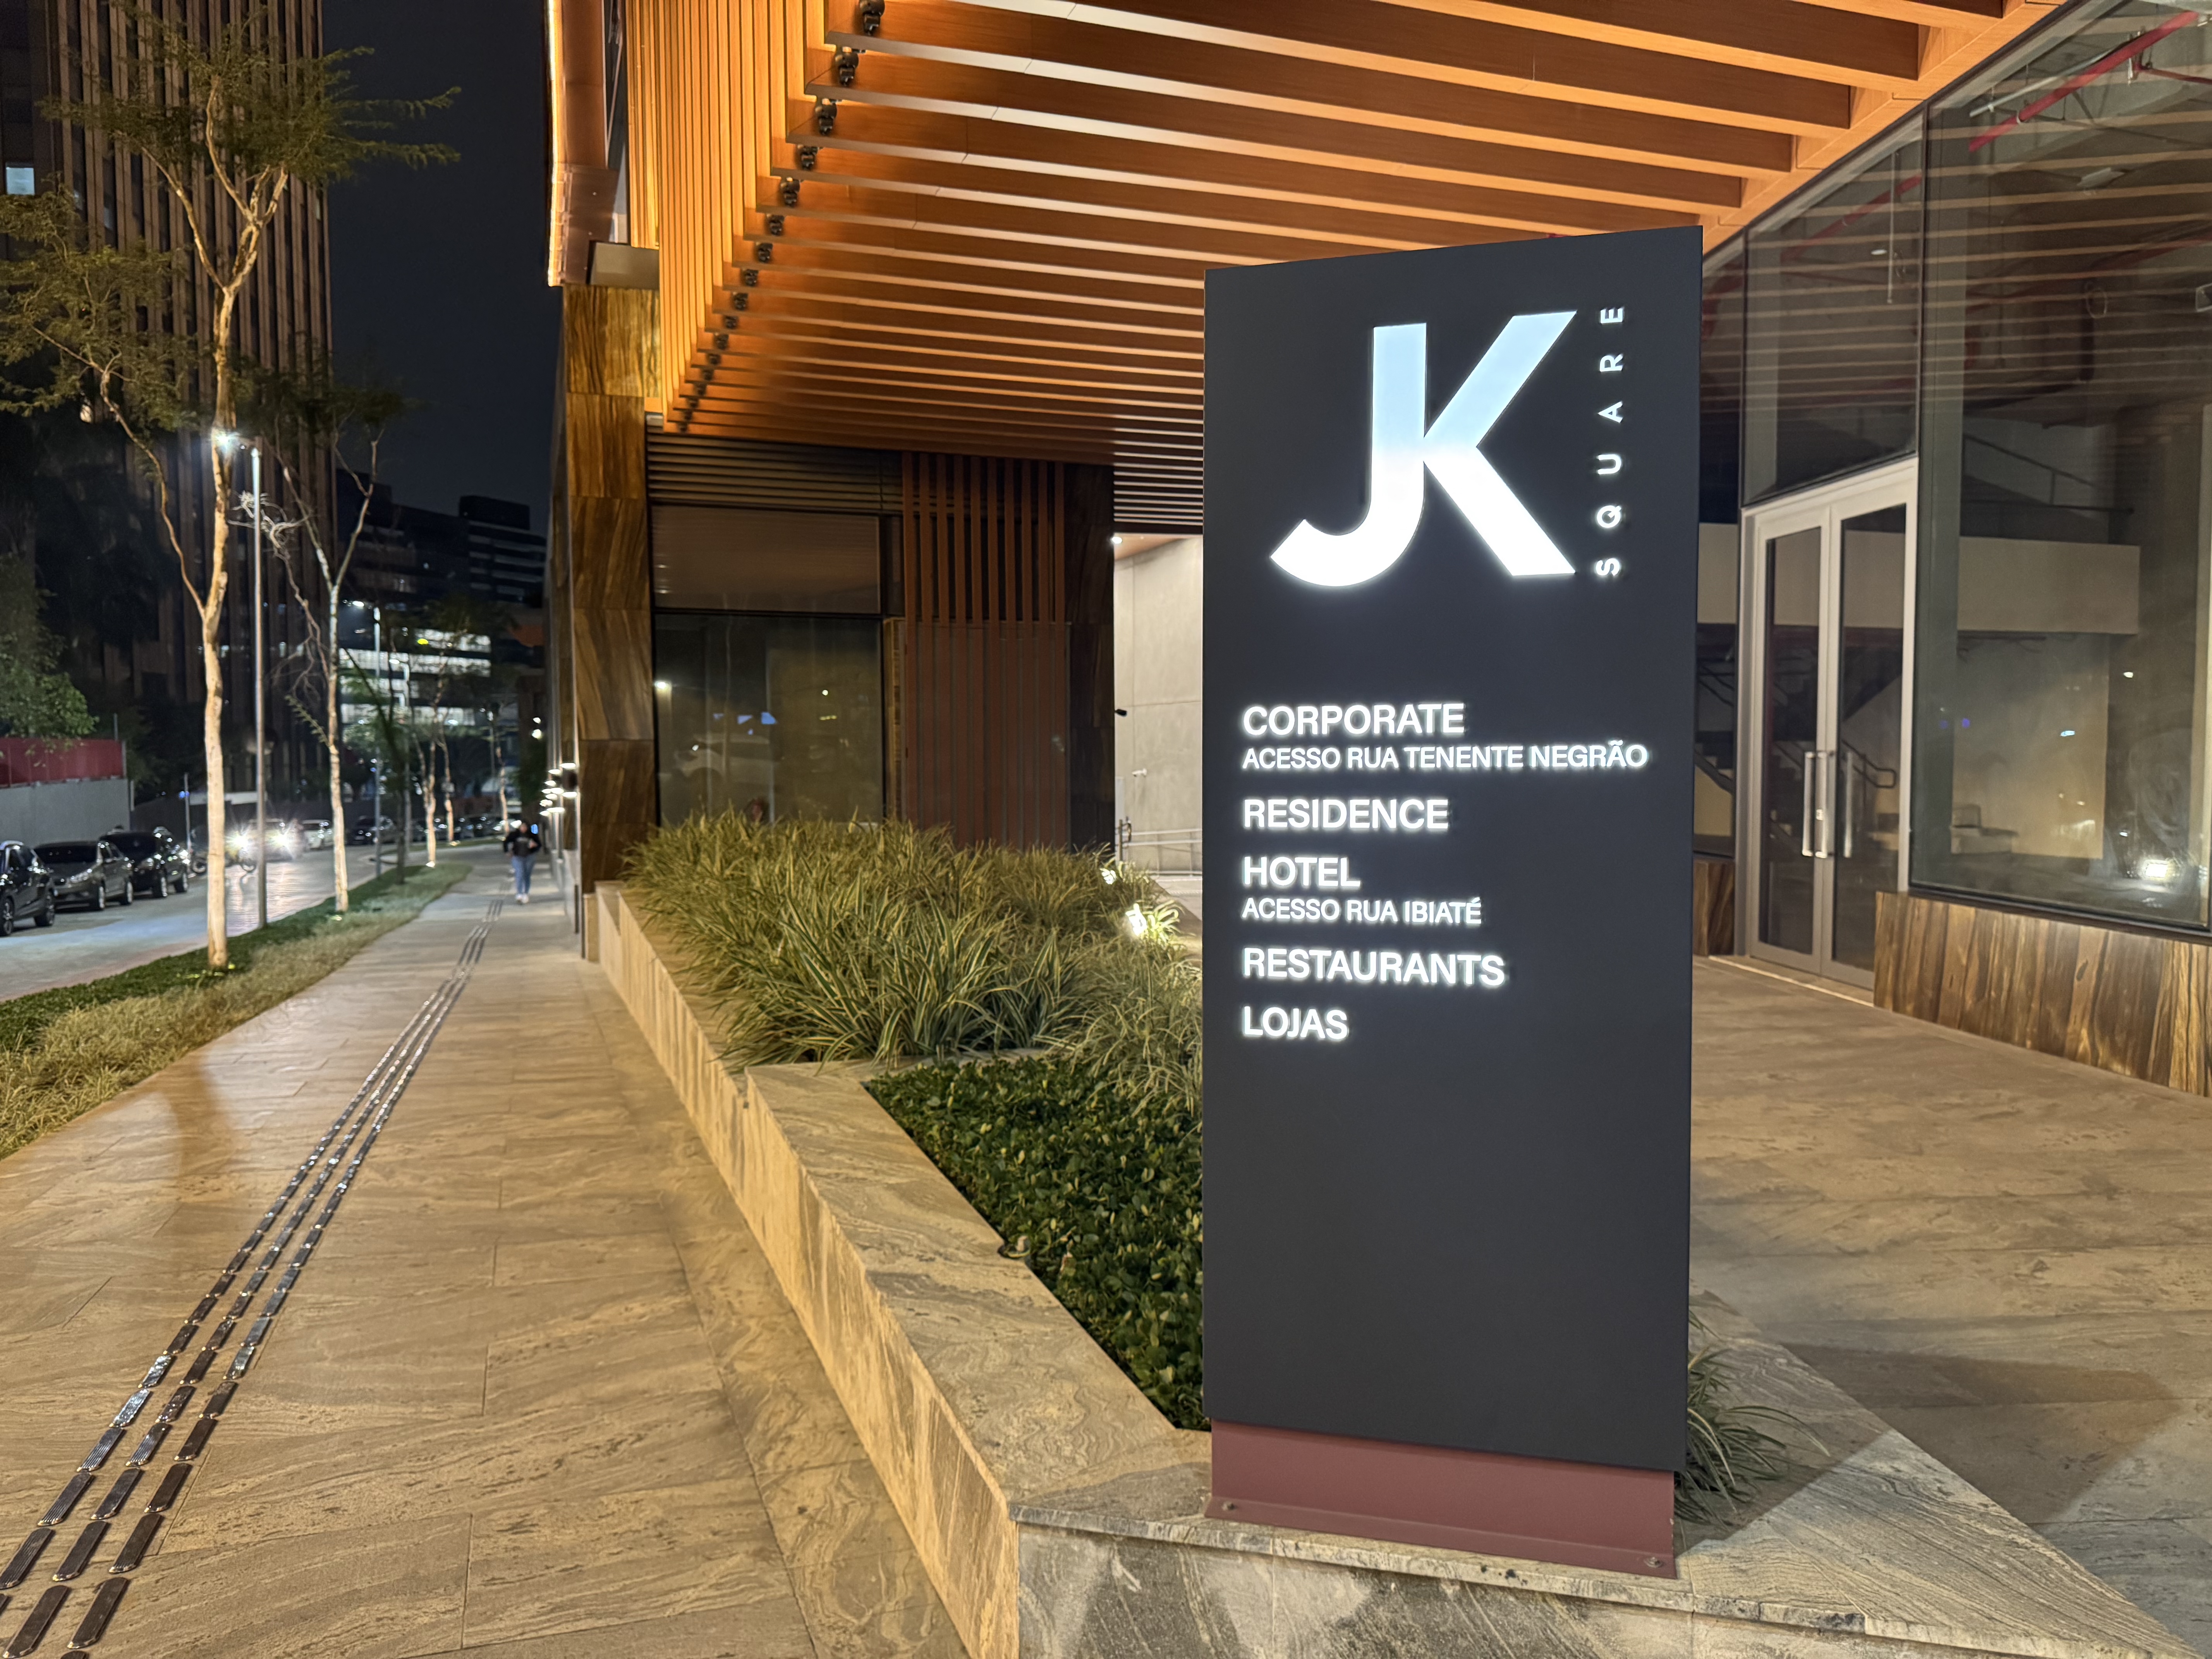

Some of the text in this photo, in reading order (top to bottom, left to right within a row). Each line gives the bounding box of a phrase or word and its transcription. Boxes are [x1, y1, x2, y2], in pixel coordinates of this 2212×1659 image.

[1270, 311, 1577, 589] JK
[1595, 307, 1624, 578] SQUARE
[1242, 703, 1465, 737] CORPORATE
[1242, 740, 1649, 771] ACESSO RUA TENENTE NEGRÃO
[1243, 799, 1449, 831] RESIDENCE
[1242, 856, 1361, 889] HOTEL
[1242, 897, 1482, 925] ACESSO RUA IBIATÉ
[1243, 948, 1506, 988] RESTAURANTS
[1242, 1007, 1349, 1042] LOJAS
